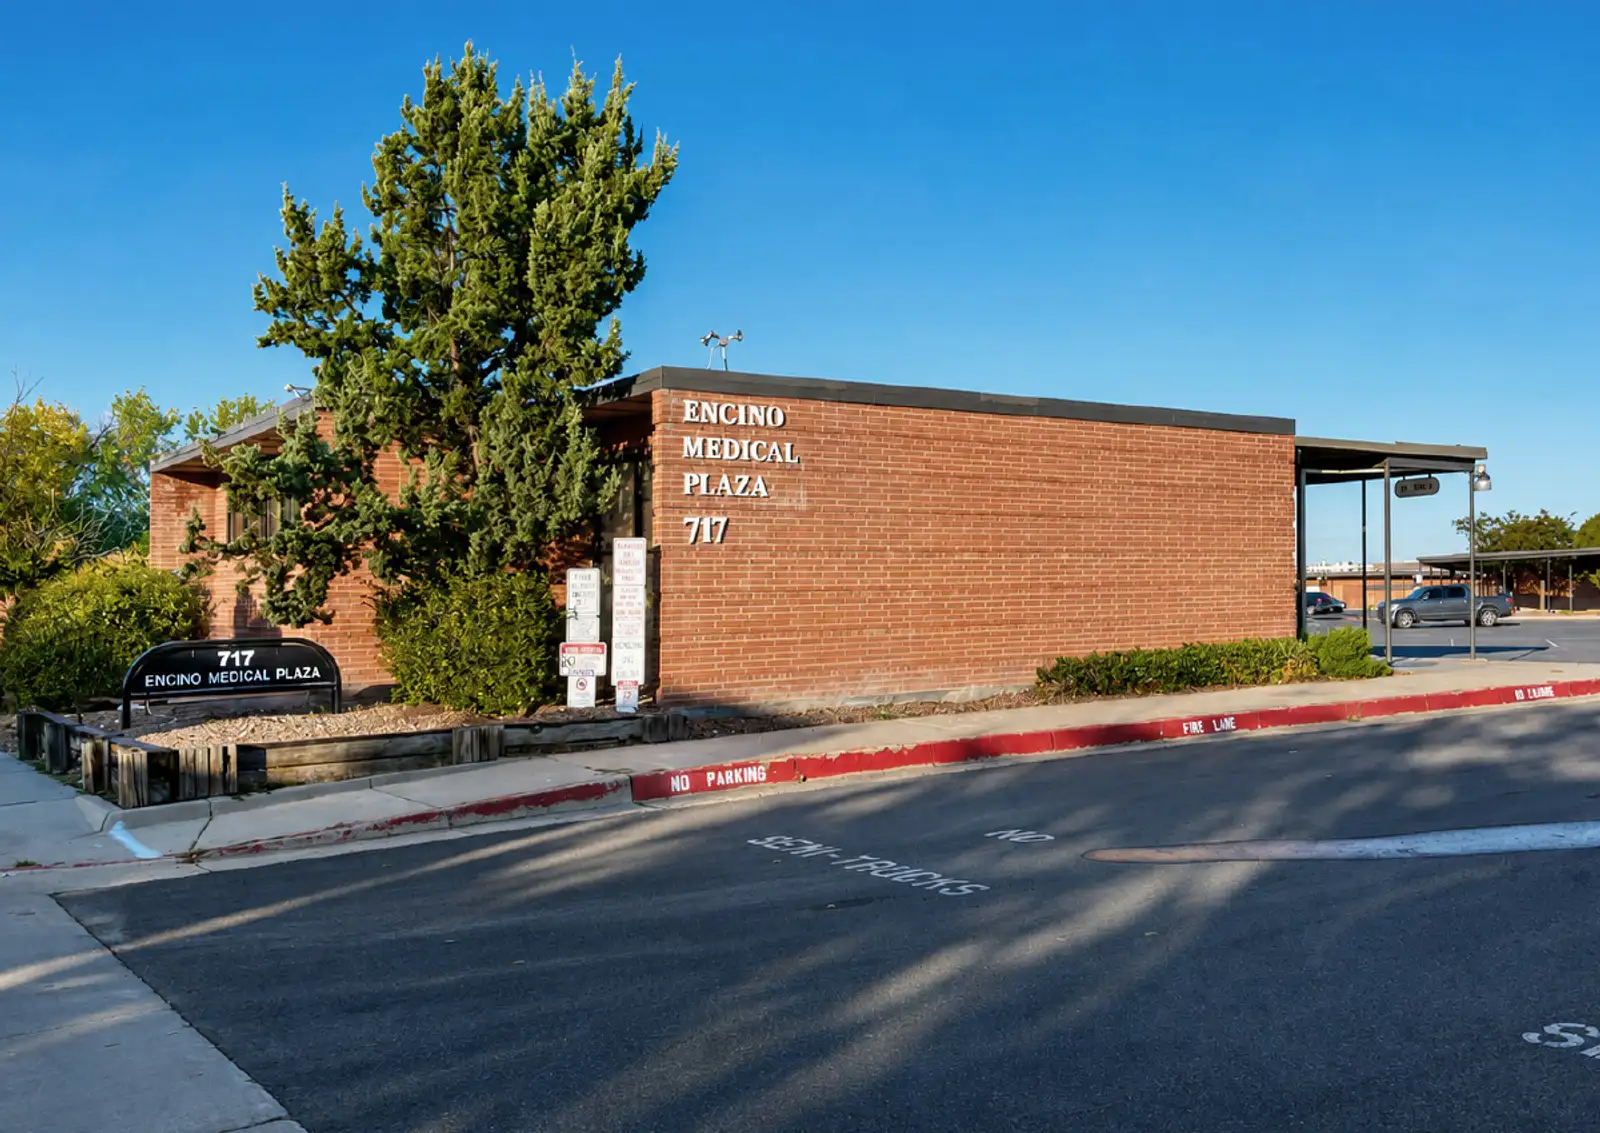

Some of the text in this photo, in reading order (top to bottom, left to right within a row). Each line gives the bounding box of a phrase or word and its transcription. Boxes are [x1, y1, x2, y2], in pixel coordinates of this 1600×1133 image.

[683, 399, 785, 427] ENCINO
[682, 436, 800, 463] MEDICAL
[683, 472, 769, 497] PLAZA
[683, 516, 729, 544] 717
[217, 650, 255, 667] 717
[145, 666, 321, 687] ENCINO MEDICAL PLAZA
[1182, 720, 1204, 735] FIRE
[670, 765, 766, 792] NO PARKING
[984, 829, 1055, 843] NO
